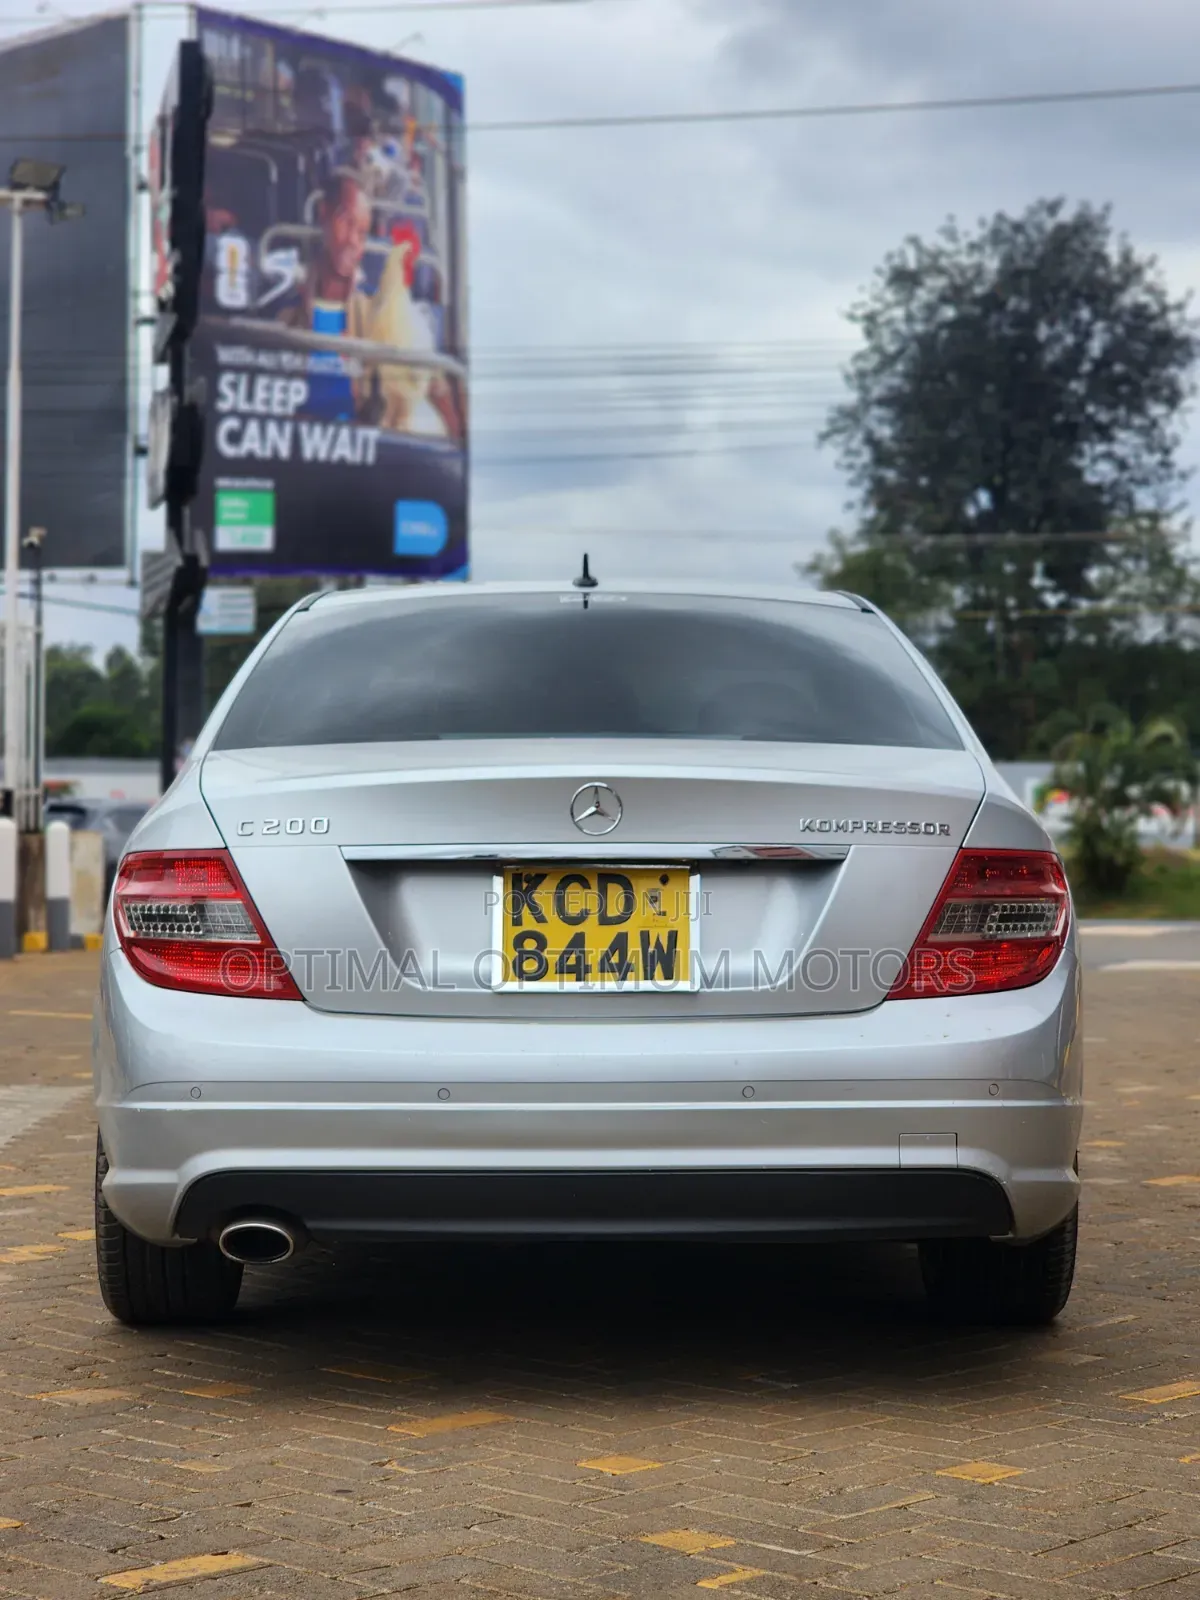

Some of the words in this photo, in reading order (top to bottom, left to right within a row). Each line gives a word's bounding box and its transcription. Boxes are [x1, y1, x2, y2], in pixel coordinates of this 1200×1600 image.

[215, 371, 309, 416] SLEEP
[216, 416, 292, 461] CAN
[299, 422, 380, 466] WAIT
[236, 819, 255, 836] C
[261, 817, 330, 835] 200
[799, 817, 951, 836] KOMPRESSOR
[511, 872, 635, 927] KCD
[511, 930, 678, 982] 844W
